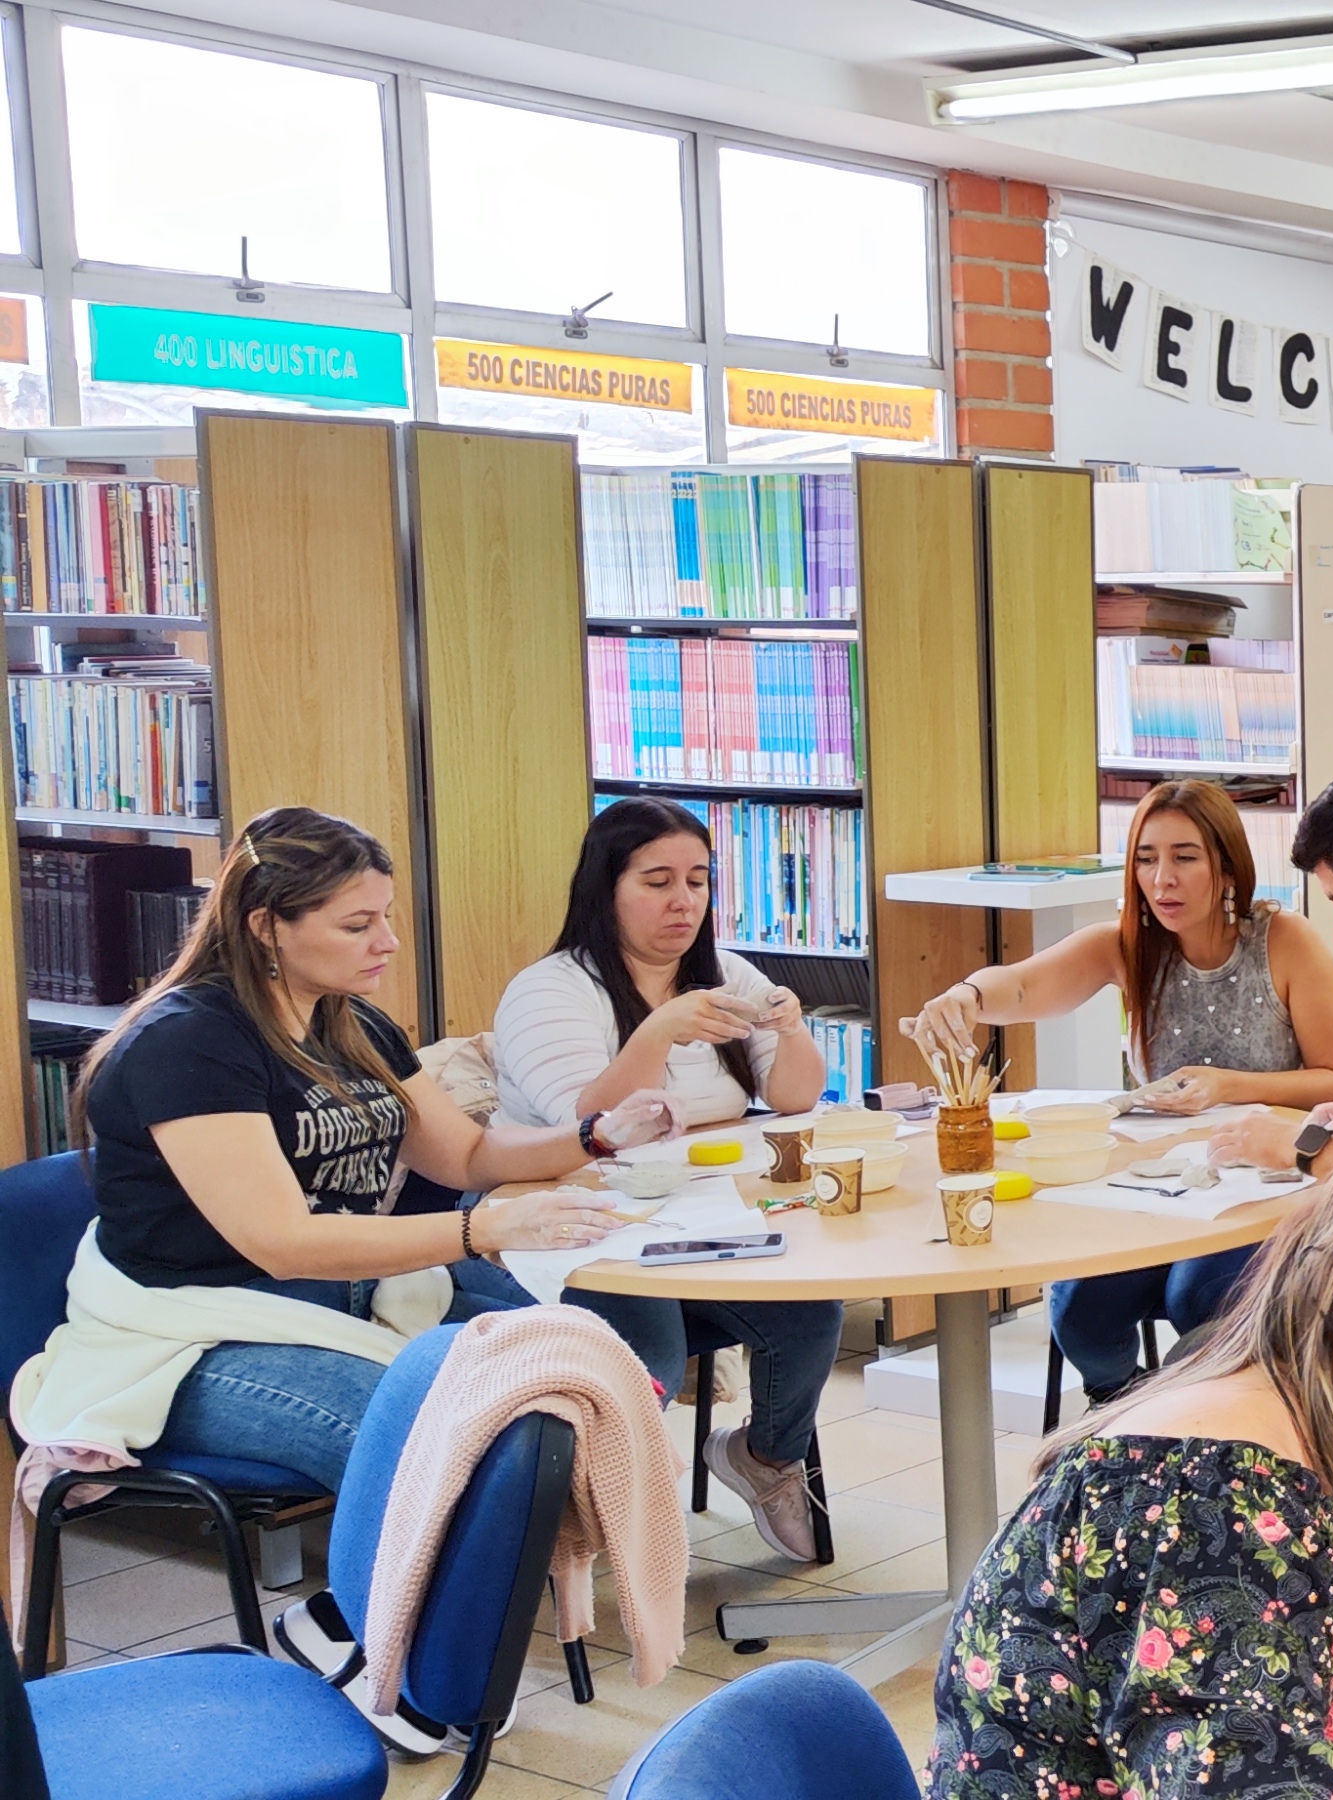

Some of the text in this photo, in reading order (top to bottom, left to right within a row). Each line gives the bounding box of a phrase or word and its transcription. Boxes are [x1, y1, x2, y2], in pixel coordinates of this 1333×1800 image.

[153, 333, 359, 380] 400 LINGUISTICA
[466, 351, 671, 407] 500 CIENCIAS PURAS
[746, 388, 913, 430] 500 CIENCIAS PURAS
[294, 1105, 371, 1158] DODGE
[309, 1143, 391, 1195] KANSAS
